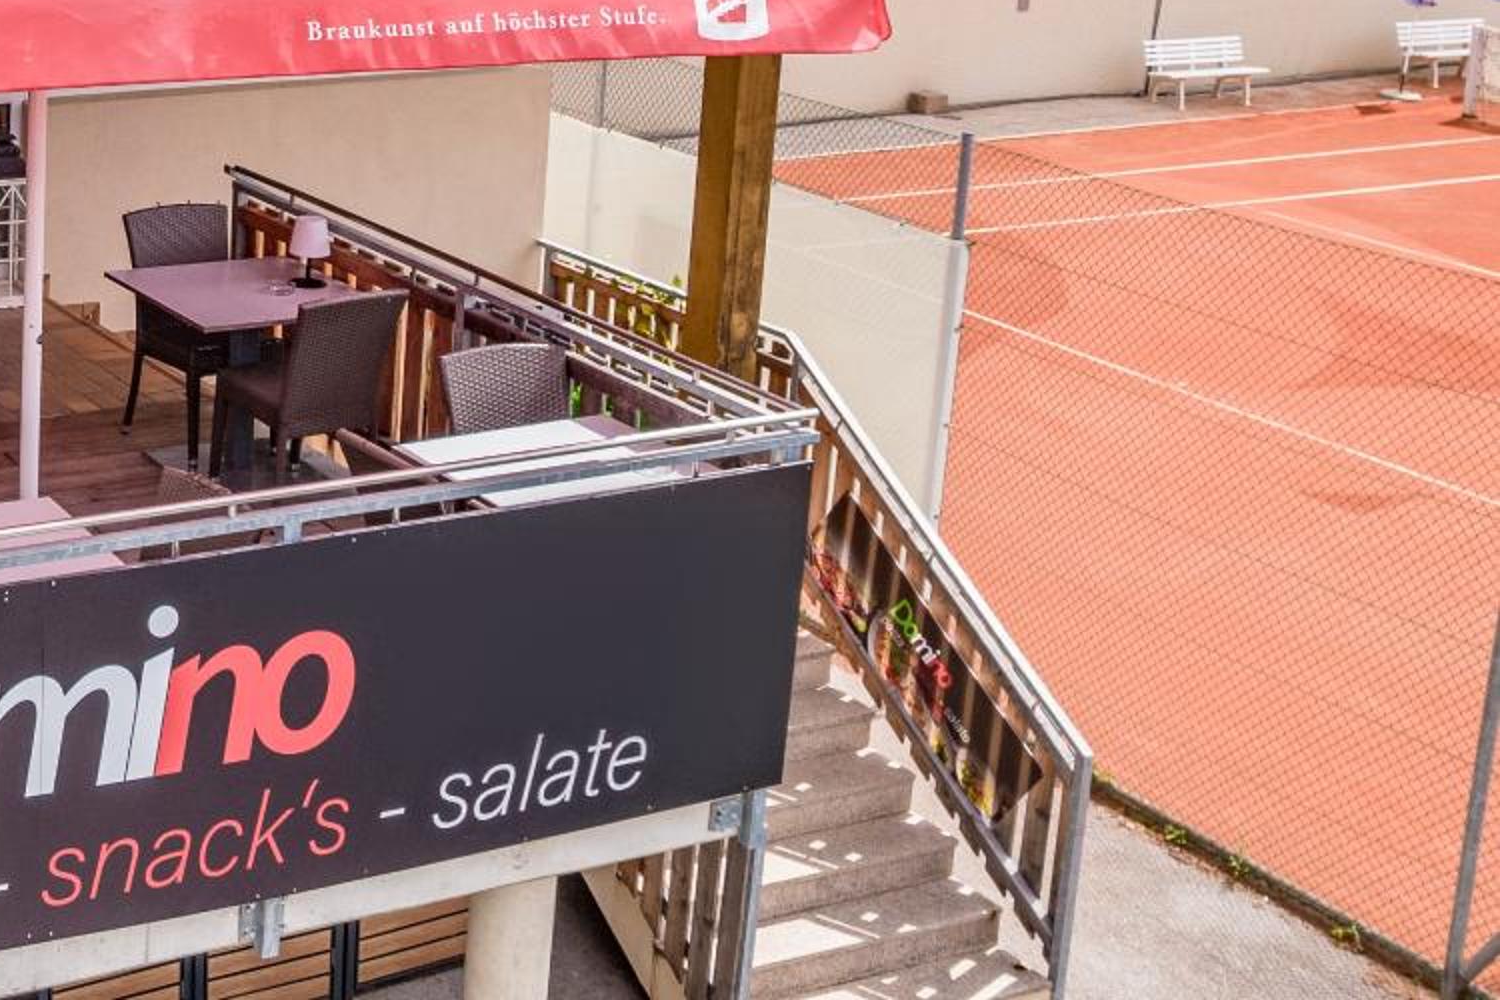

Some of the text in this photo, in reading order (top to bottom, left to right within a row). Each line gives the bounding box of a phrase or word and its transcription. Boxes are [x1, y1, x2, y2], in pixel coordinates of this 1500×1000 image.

[307, 18, 436, 41] Braukunst
[445, 13, 485, 34] auf
[493, 8, 591, 32] höchster
[890, 599, 952, 689] Domino
[40, 778, 351, 908] snack's
[432, 728, 649, 830] salate
